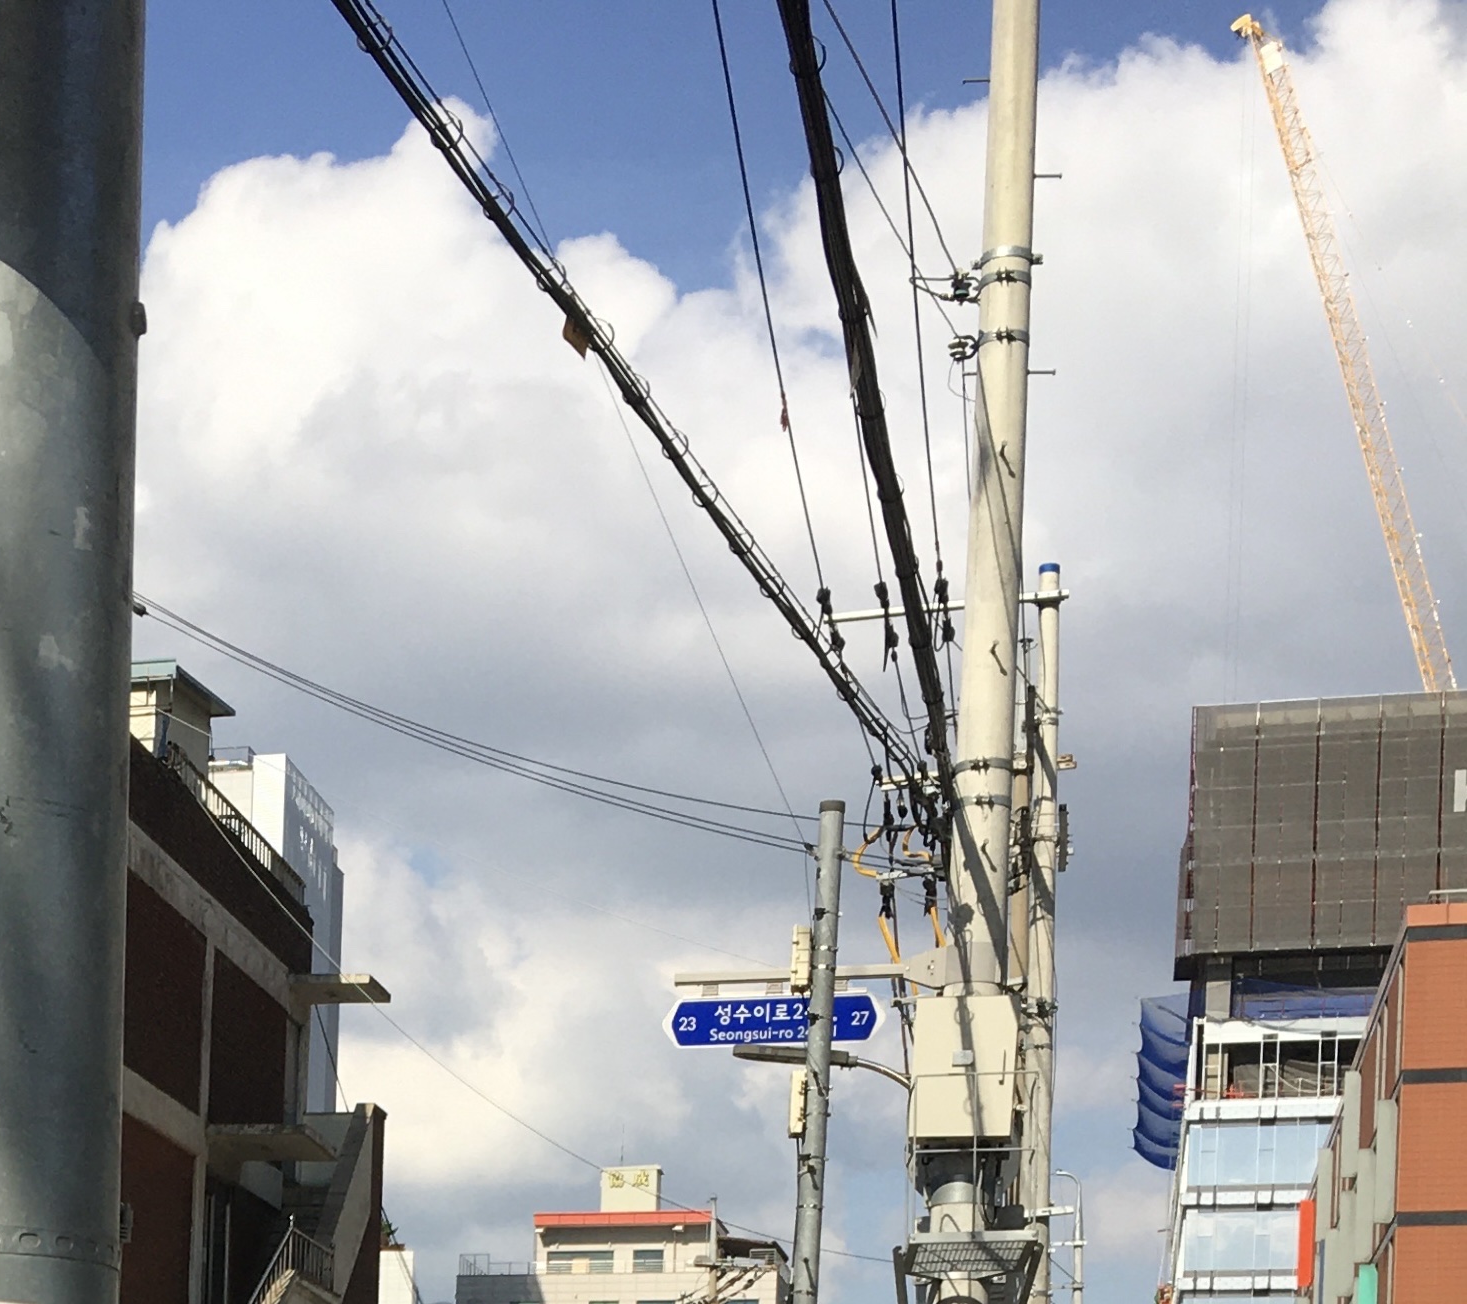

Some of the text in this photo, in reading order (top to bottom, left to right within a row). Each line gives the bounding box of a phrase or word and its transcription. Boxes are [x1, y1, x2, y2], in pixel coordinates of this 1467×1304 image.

[714, 1003, 837, 1026] 성수이로2
[851, 1010, 870, 1026] 27
[679, 1016, 697, 1032] 23
[709, 1027, 794, 1043] Seongsui-ro
